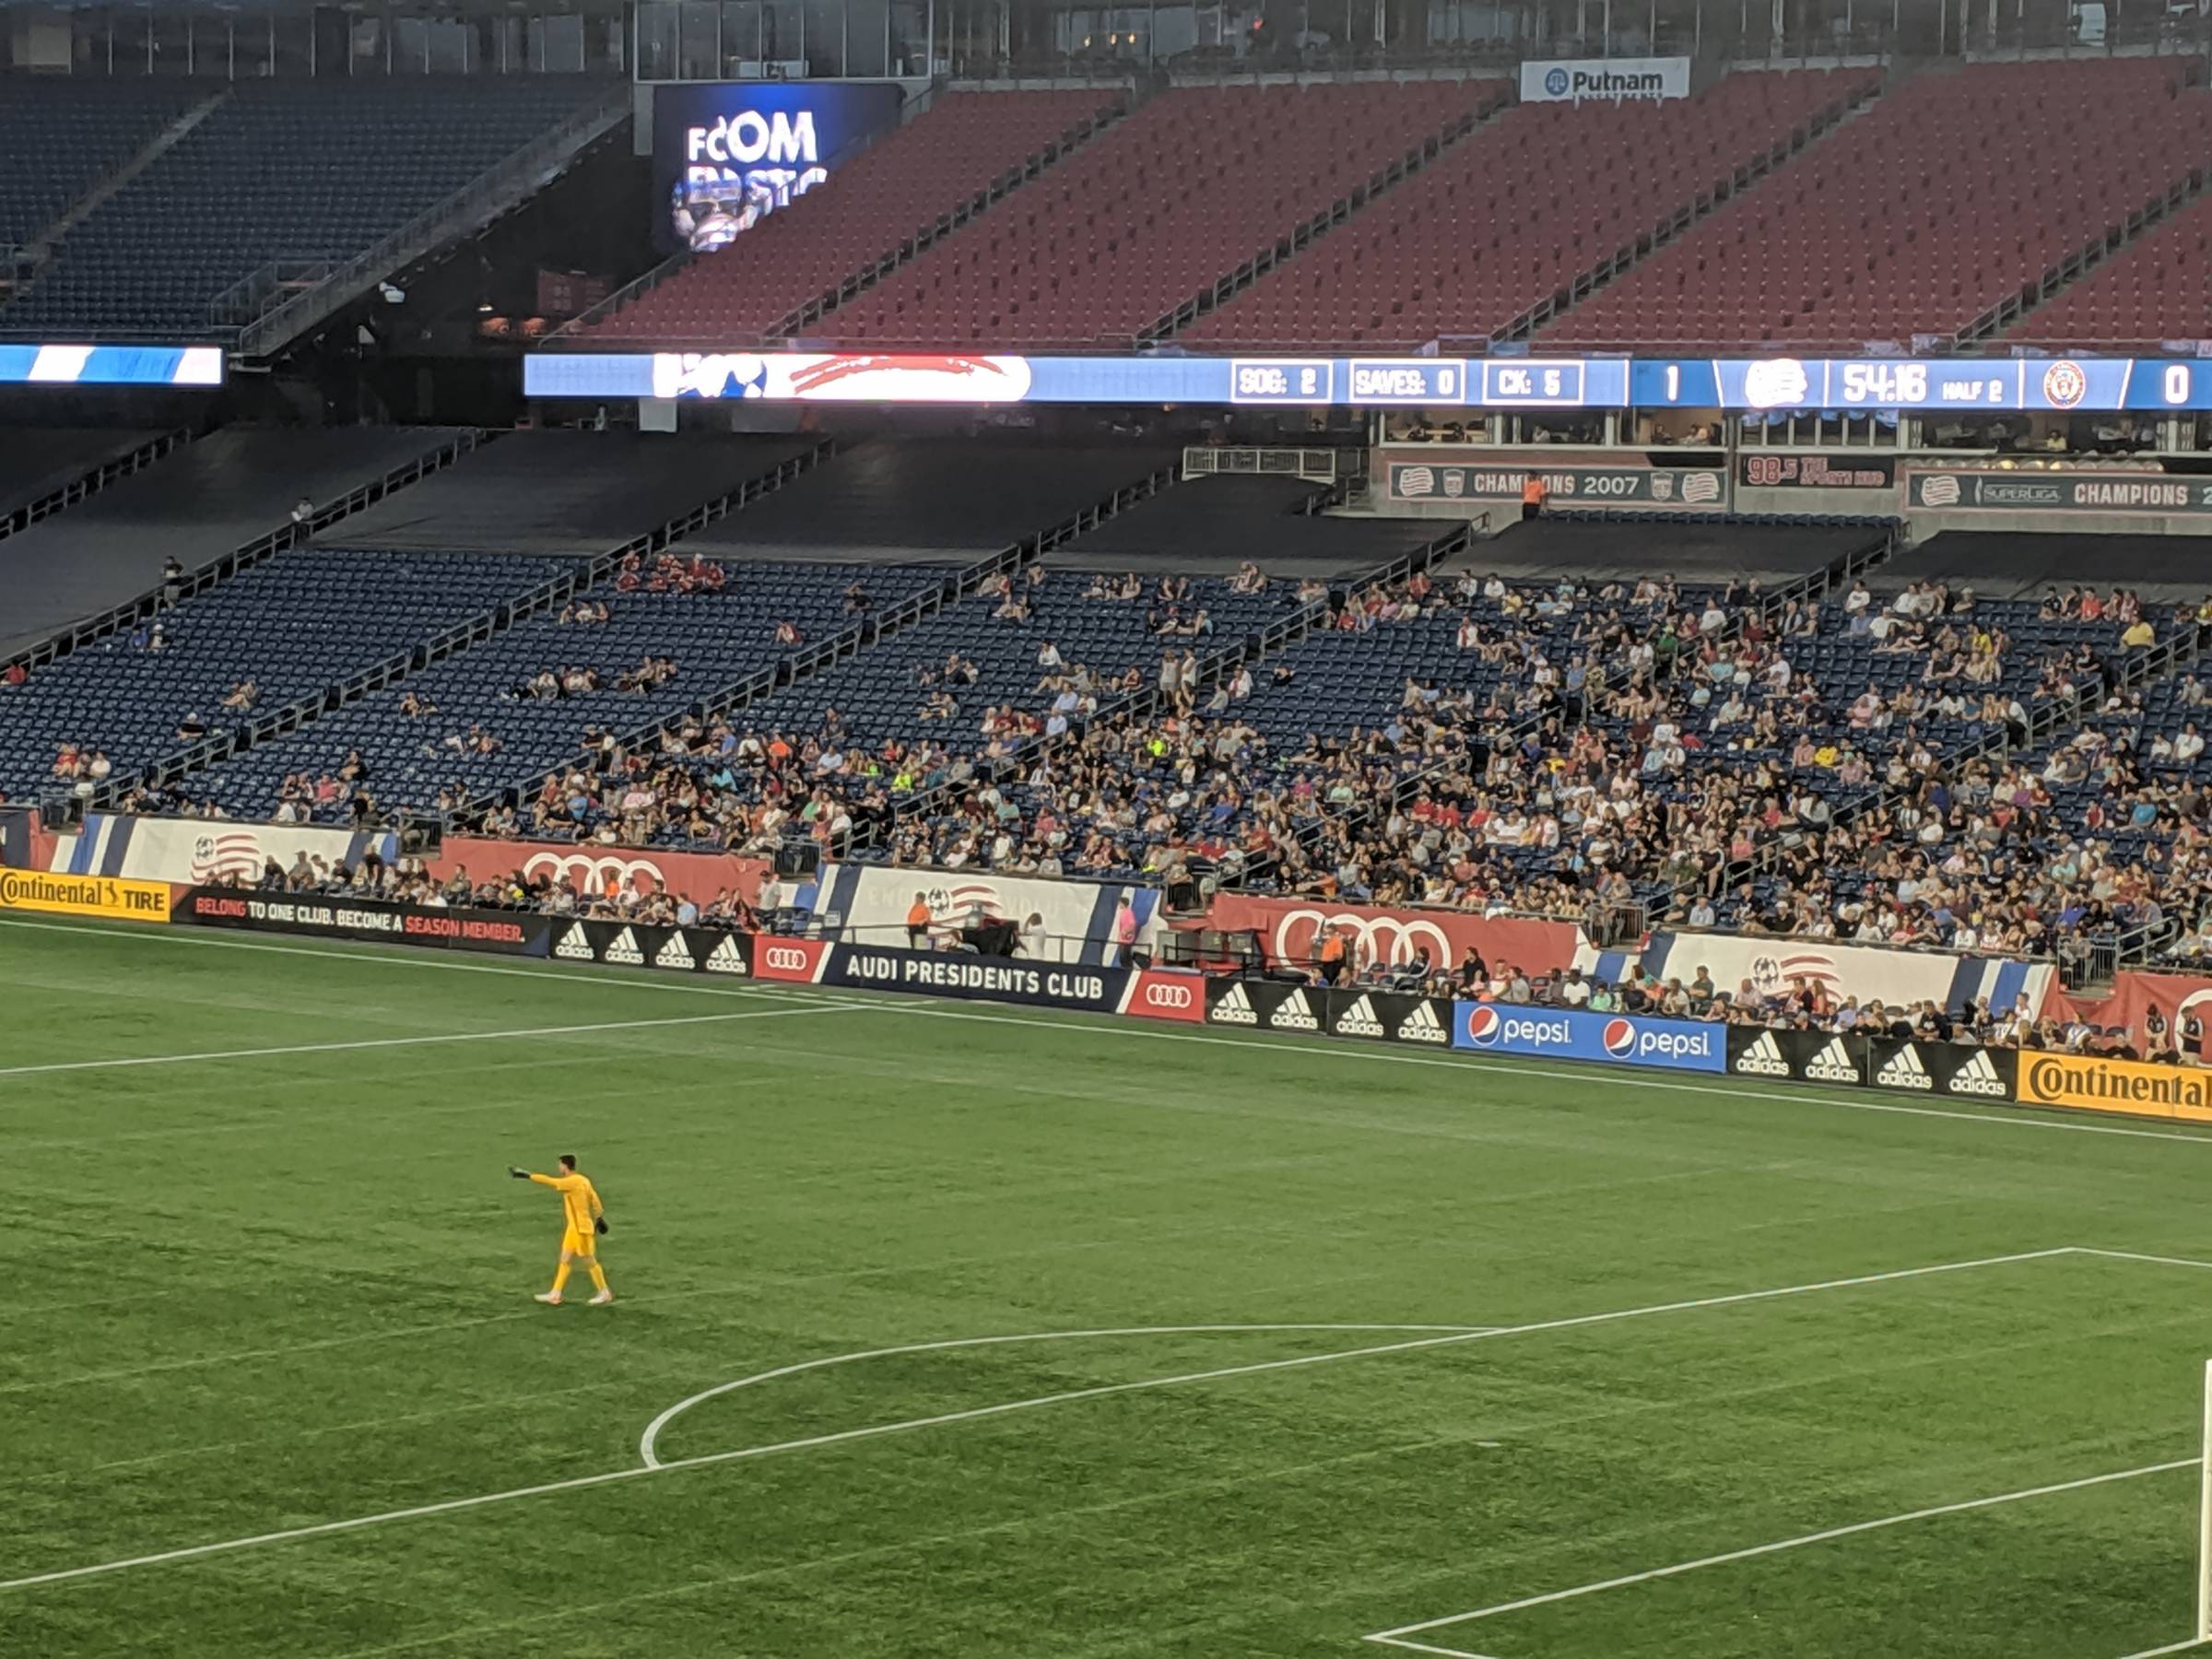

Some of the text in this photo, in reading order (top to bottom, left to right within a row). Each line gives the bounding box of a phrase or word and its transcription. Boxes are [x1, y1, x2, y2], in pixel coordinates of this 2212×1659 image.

[1572, 69, 1664, 92] Putnam
[1300, 369, 1316, 394] 2
[1355, 370, 1454, 395] SAVES: 0
[1544, 370, 1561, 395] 5
[1666, 365, 1678, 401] 1
[1942, 380, 2003, 402] HALF 2
[2165, 365, 2189, 404] 0
[1475, 473, 1639, 495] CHAMONS 2007
[2074, 483, 2189, 505] CHAMPIONS
[0, 872, 165, 912] Continental TIRE
[195, 897, 525, 943] BELONG TO ONE CLUB. BECOME A SEASON MEMBER.
[555, 945, 595, 960] adidas
[605, 949, 644, 965] adidas
[655, 954, 696, 970] adidas
[706, 958, 747, 974] adidas
[846, 955, 1103, 999] AUDI PRESIDENTS CLUB
[1211, 1007, 1258, 1025] adidas
[1270, 1012, 1319, 1030] adidas
[1336, 1018, 1384, 1037] adidas
[1398, 1025, 1448, 1042] adidas
[1503, 1018, 1571, 1047] pepsi
[1640, 1030, 1709, 1059] pepsi
[1736, 1057, 1790, 1077] adidas
[1805, 1063, 1859, 1083] adidas
[1877, 1069, 1933, 1089] adidas
[1949, 1077, 2006, 1097] adidas
